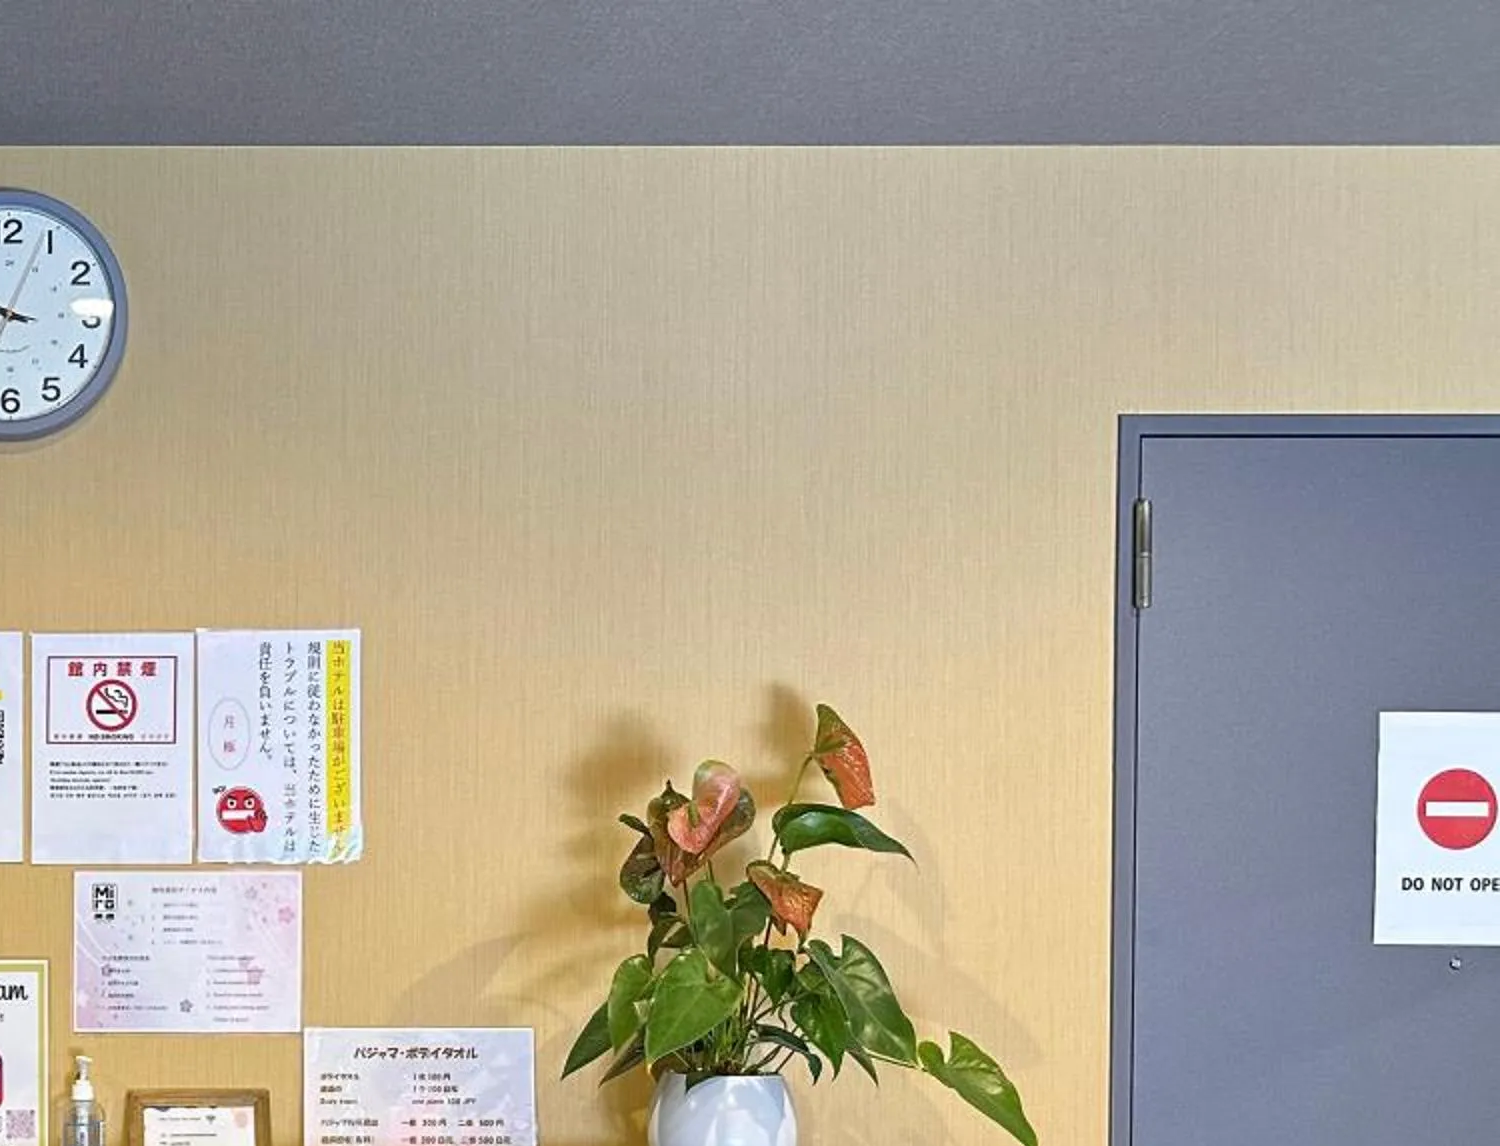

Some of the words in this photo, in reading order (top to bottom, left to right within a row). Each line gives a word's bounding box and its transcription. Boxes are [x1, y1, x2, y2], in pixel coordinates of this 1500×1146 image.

[47, 230, 53, 254] 1
[71, 261, 91, 286] 2
[68, 344, 88, 369] 4
[1, 388, 21, 413] 6
[41, 377, 61, 402] 5
[1401, 877, 1424, 891] DO
[1431, 877, 1464, 891] NOT
